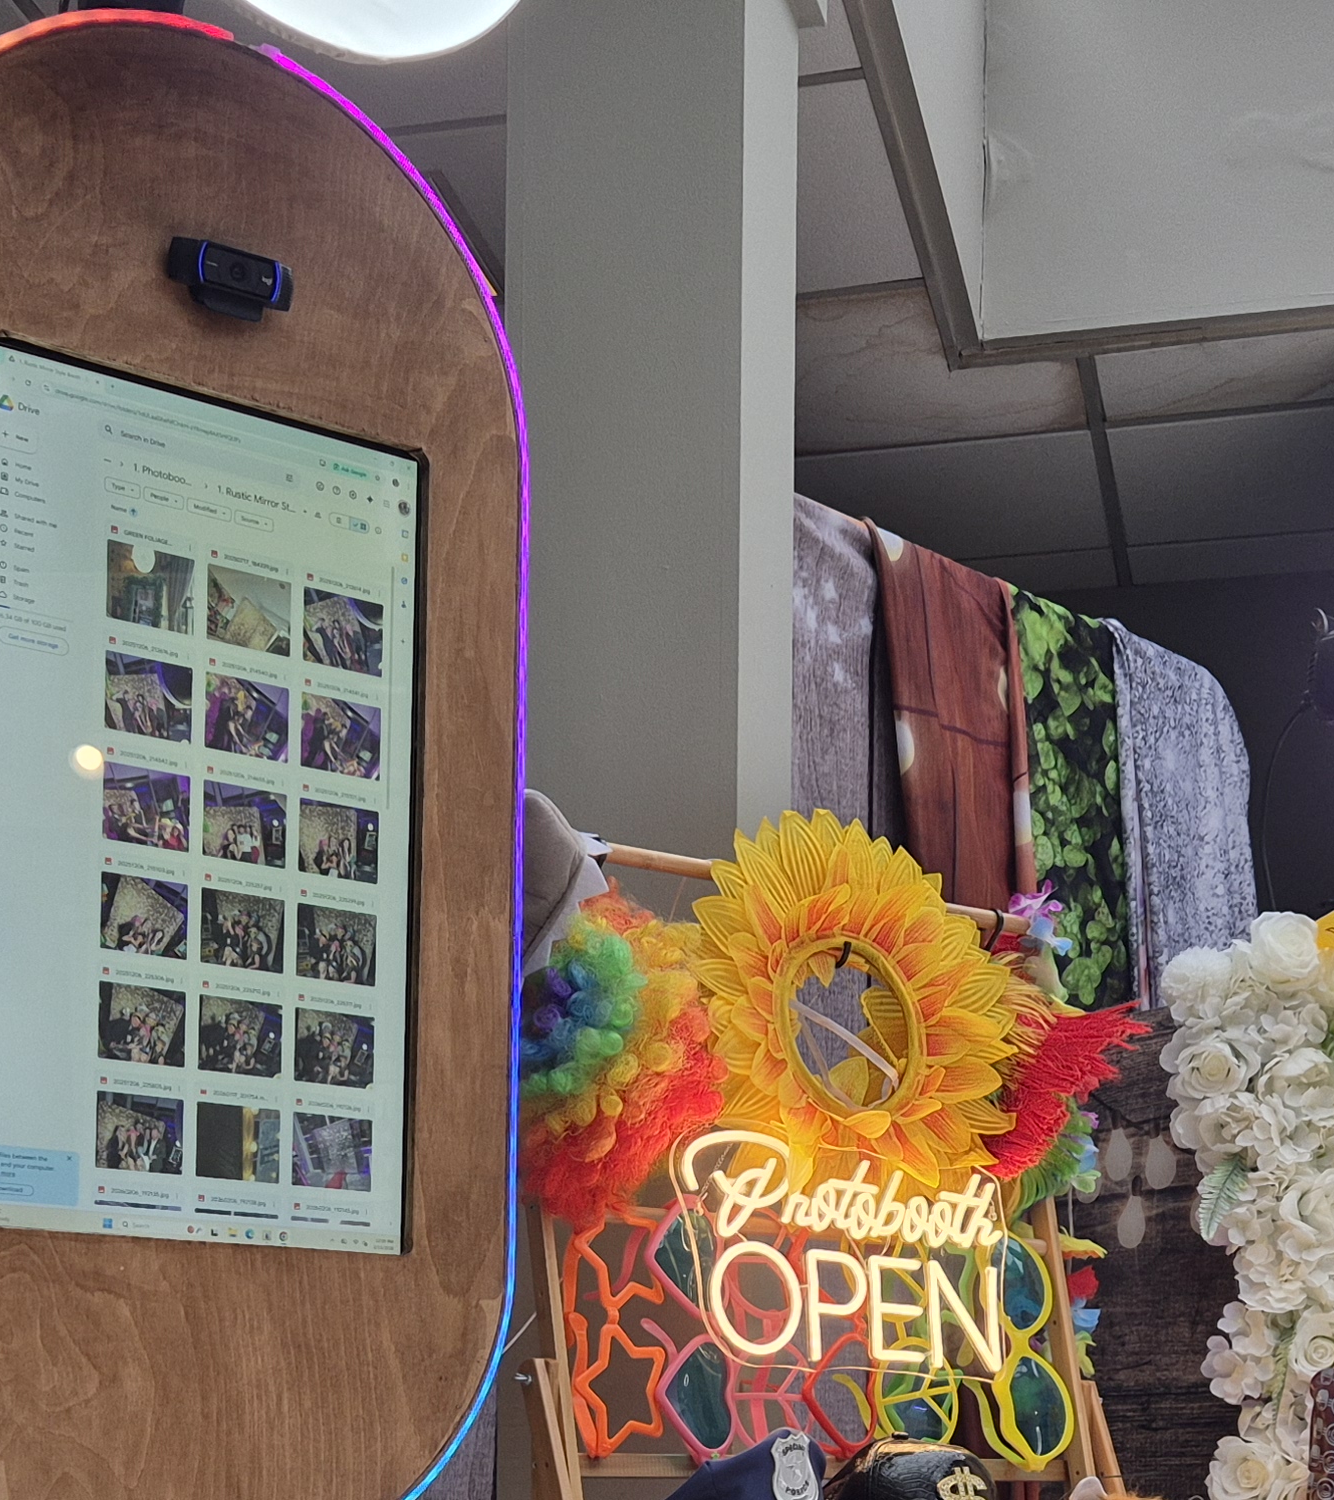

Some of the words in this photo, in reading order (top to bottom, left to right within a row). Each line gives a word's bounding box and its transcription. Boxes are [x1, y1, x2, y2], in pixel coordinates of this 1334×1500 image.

[18, 401, 40, 416] Drive
[120, 430, 143, 443] Search
[149, 437, 166, 449] Drive
[15, 462, 32, 471] Home
[24, 479, 40, 488] Drive
[111, 482, 126, 492] Type
[14, 490, 46, 504] Computers
[225, 486, 253, 502] Rustic
[253, 494, 281, 509] Mirror
[110, 504, 128, 514] Name
[14, 513, 35, 524] Shared
[35, 519, 49, 527] with
[14, 543, 35, 553] Starred
[13, 595, 35, 605] Storage
[8, 633, 20, 641] Get
[20, 636, 36, 644] more
[36, 640, 59, 650] storage
[12, 1153, 37, 1161] between
[710, 1240, 1003, 1373] OPEN
